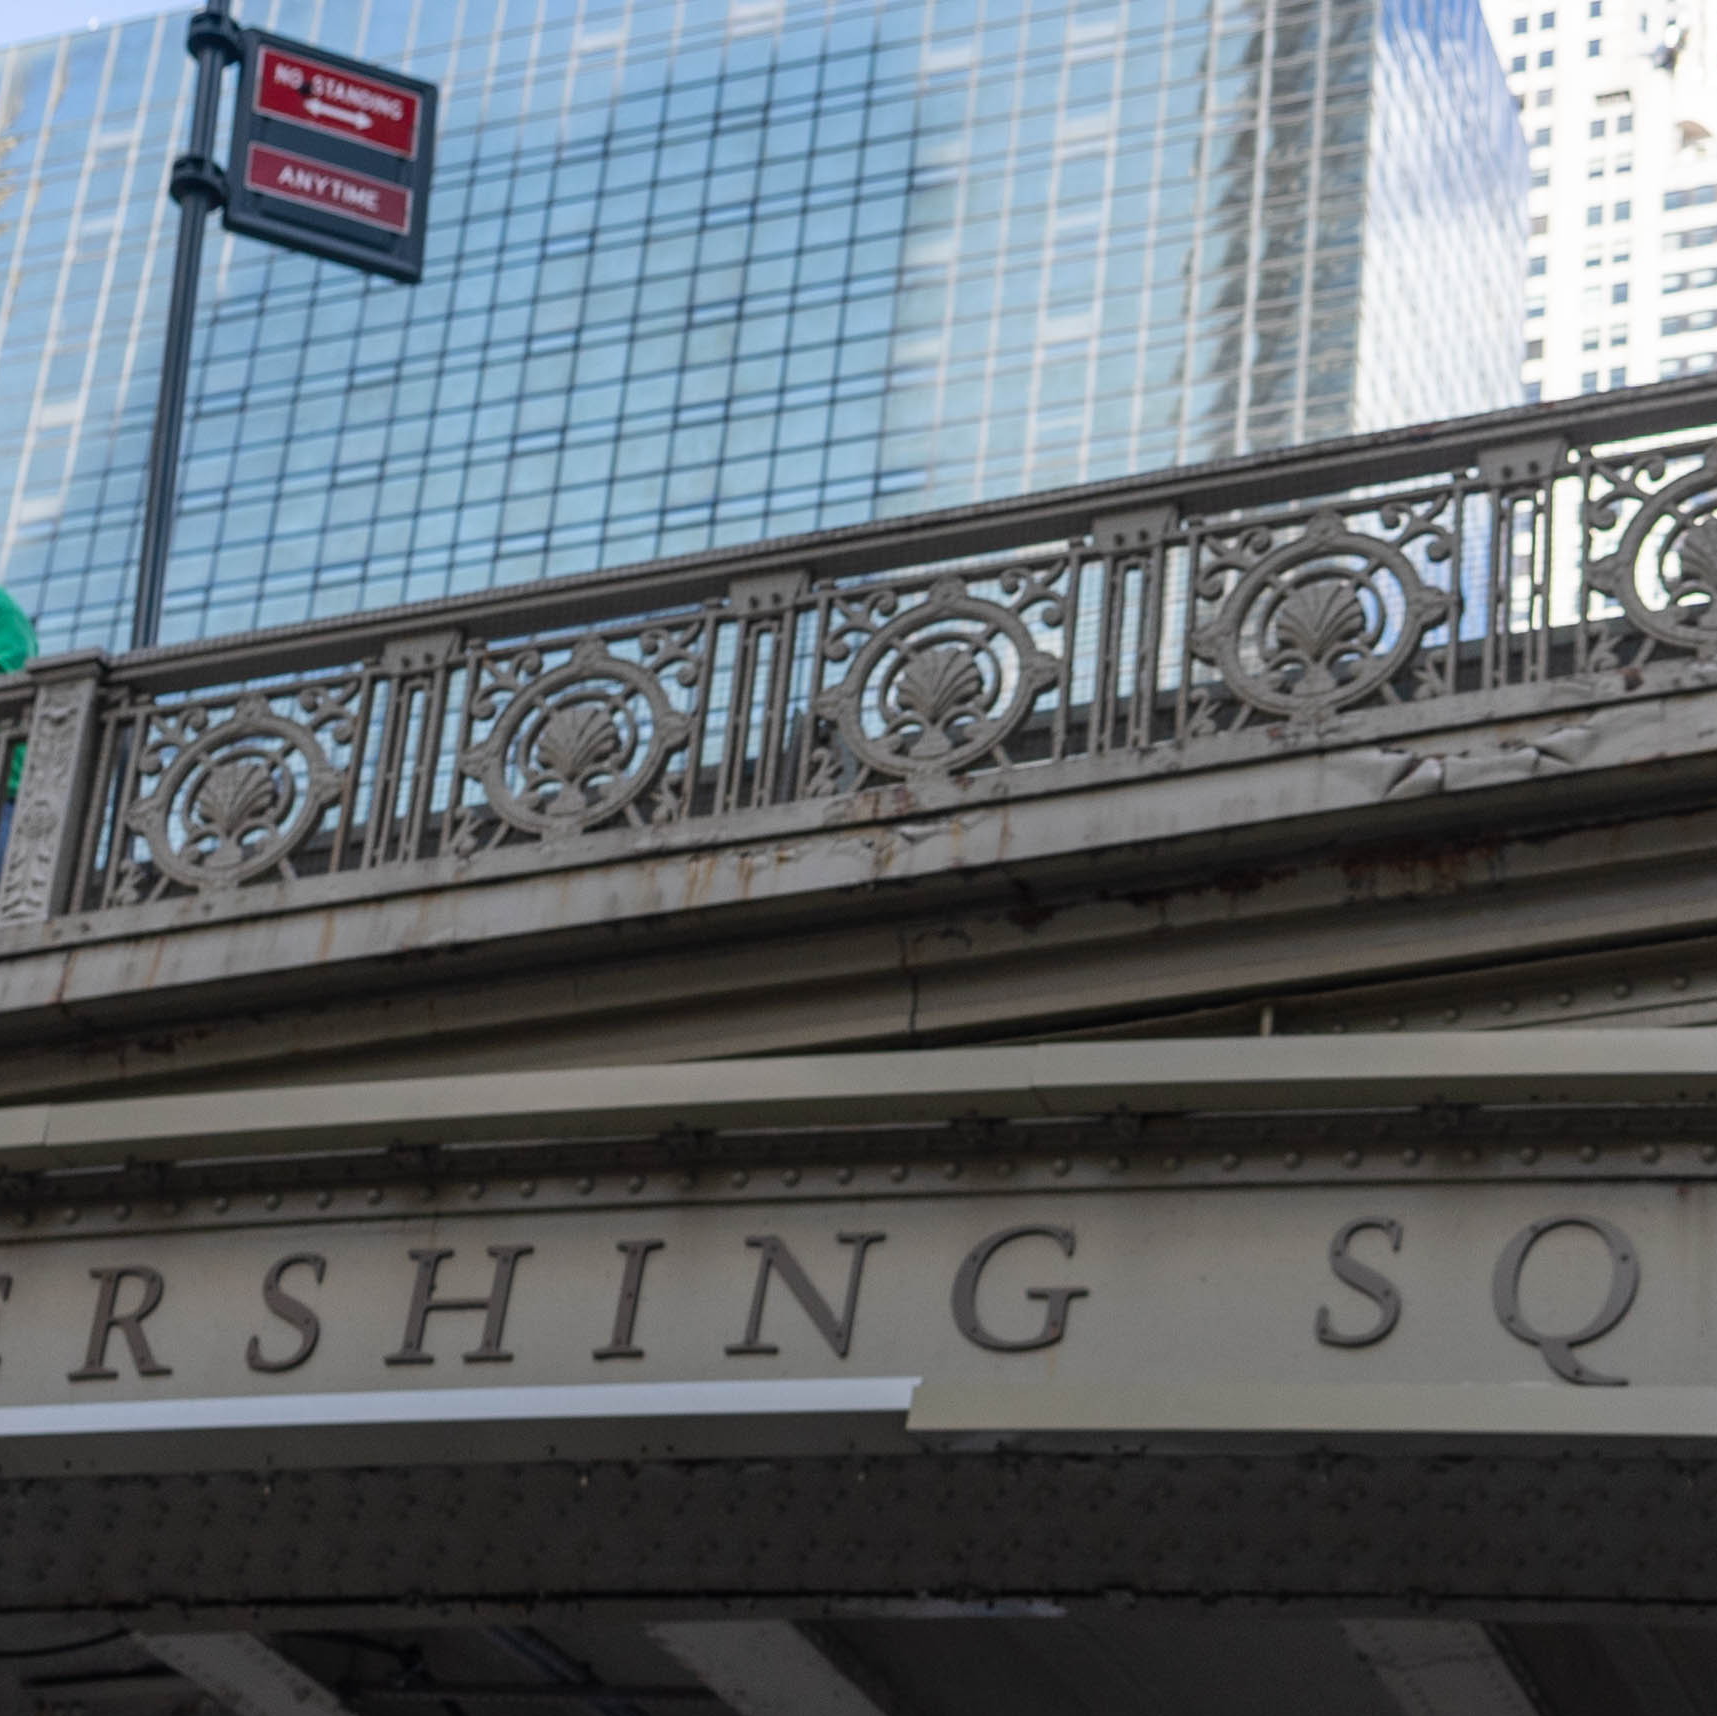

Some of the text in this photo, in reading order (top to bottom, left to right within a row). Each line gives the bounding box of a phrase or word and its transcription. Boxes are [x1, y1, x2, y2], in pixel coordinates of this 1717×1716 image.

[274, 62, 405, 121] NO STANDING
[277, 165, 380, 212] ANYTIME
